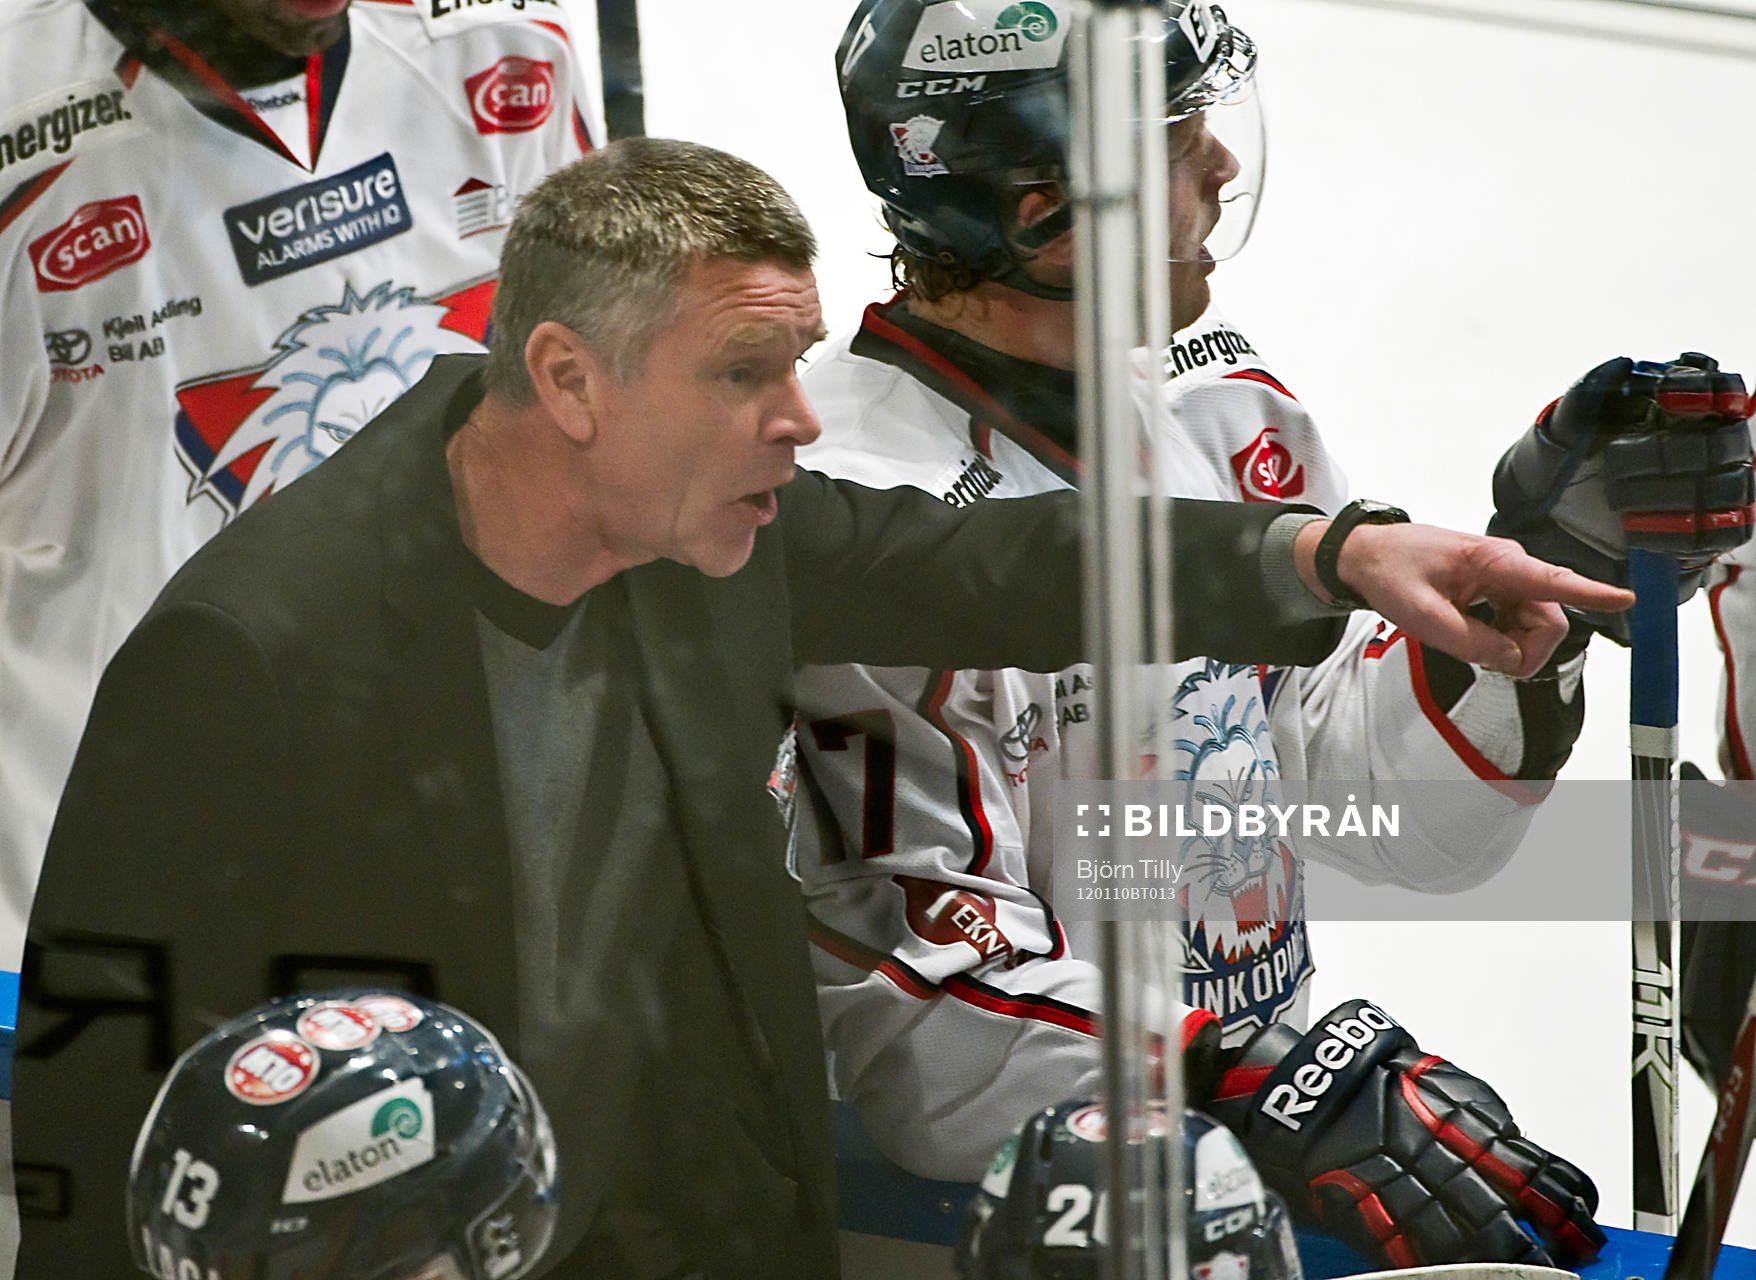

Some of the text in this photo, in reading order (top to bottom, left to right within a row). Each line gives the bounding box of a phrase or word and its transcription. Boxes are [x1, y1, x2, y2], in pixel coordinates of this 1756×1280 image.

[921, 32, 1022, 63] elaton
[897, 75, 987, 98] CCM
[237, 168, 397, 245] verisure
[57, 217, 137, 272] scan
[257, 230, 335, 270] ALARMS
[334, 210, 382, 243] WITH
[1261, 1006, 1398, 1131] Reebo
[161, 1148, 220, 1231] 13
[302, 1137, 401, 1192] elaton
